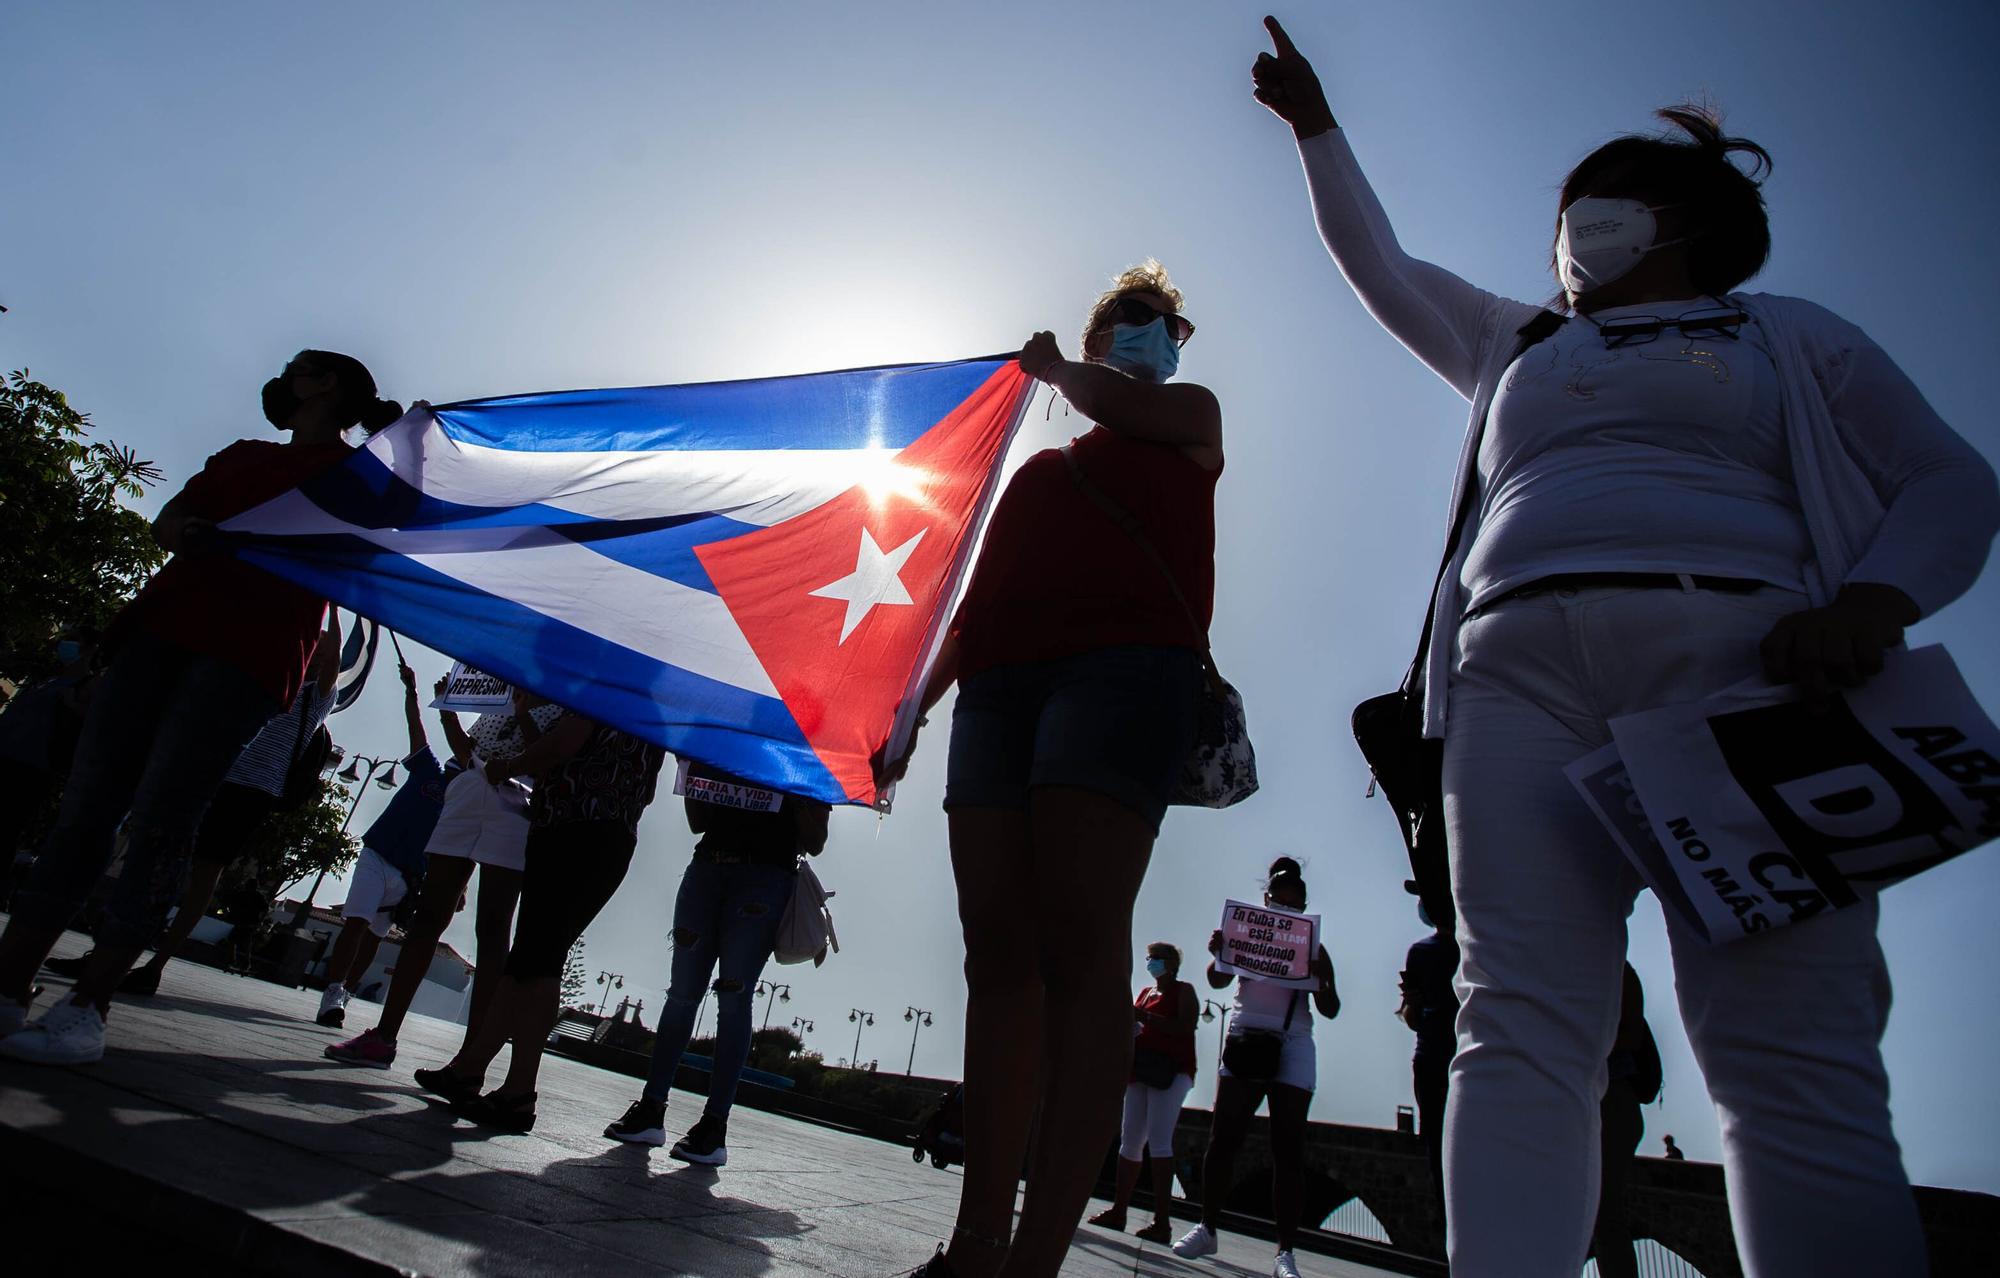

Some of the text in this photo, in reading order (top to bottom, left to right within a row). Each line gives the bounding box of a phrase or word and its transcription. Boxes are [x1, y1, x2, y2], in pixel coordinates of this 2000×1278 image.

[685, 787, 772, 810] VIVA CUBA LIBRE
[686, 778, 774, 802] PATRIA Y VIDA
[1772, 763, 1978, 886] DÍ
[1666, 816, 1770, 935] NO MÁS
[1233, 907, 1245, 921] En
[1247, 910, 1275, 928] Cuba
[1277, 917, 1293, 931] se
[1229, 938, 1295, 961] cometiendo
[1234, 953, 1289, 976] genocidio
